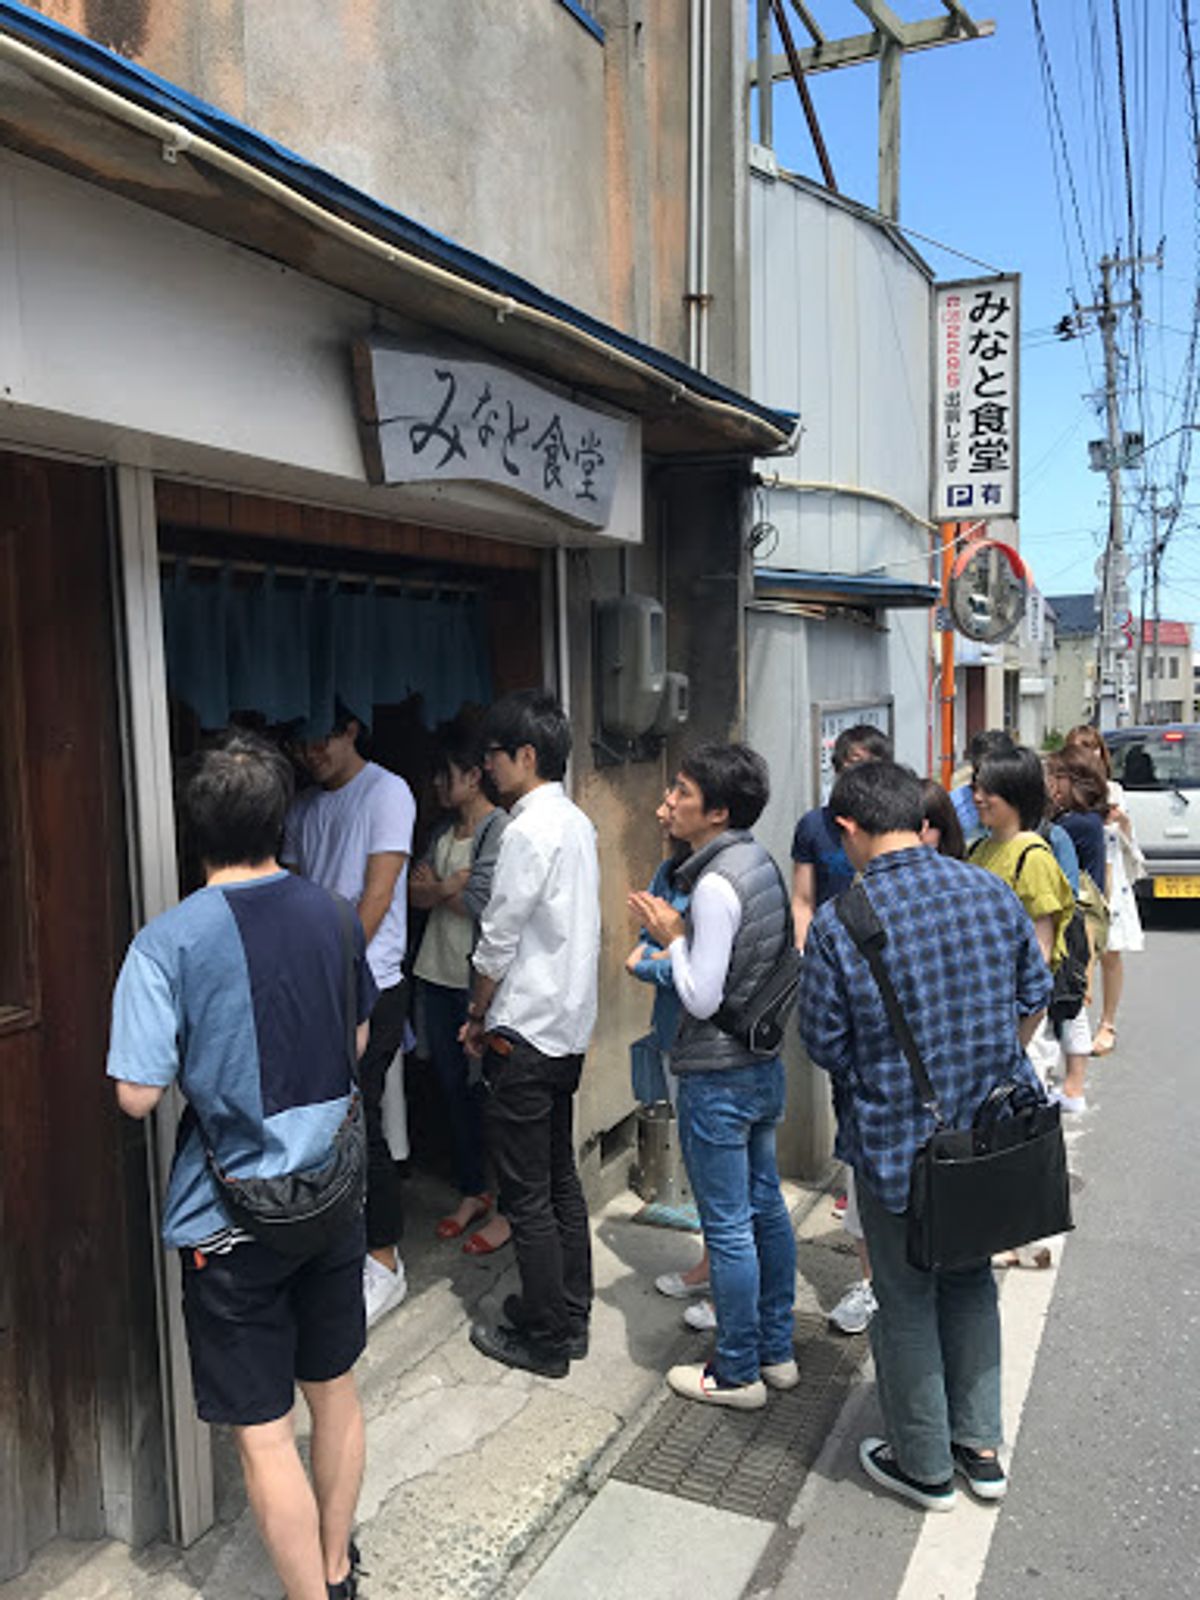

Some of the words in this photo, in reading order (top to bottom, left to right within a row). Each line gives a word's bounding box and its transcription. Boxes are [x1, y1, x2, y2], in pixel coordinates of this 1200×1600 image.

[409, 368, 605, 501] みなと食堂
[968, 290, 1010, 473] みなと食堂
[980, 483, 1002, 505] 有
